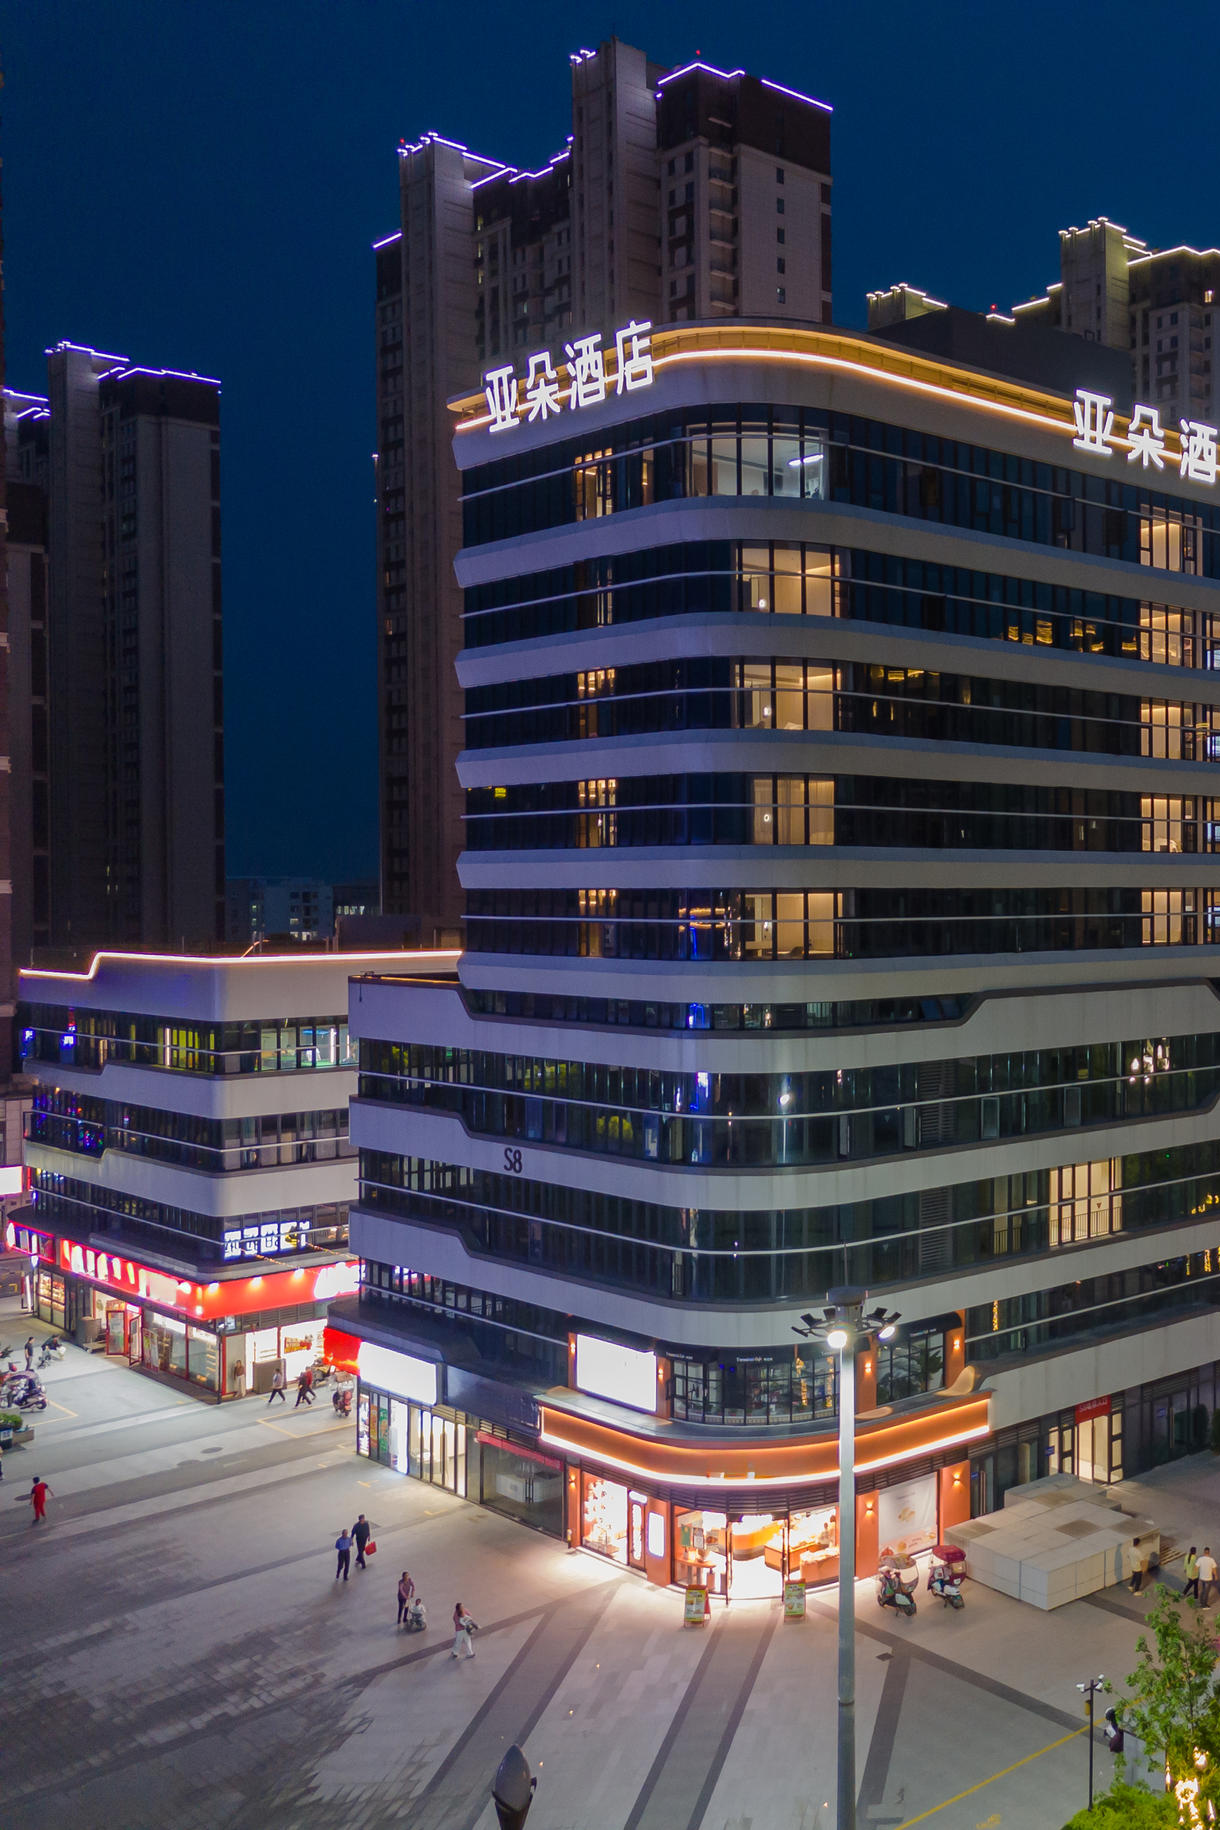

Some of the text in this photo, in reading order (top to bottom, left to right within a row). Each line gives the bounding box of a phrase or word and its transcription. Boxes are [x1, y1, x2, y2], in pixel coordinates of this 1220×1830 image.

[486, 320, 653, 432] 亚朵酒店
[504, 1147, 523, 1173] S8
